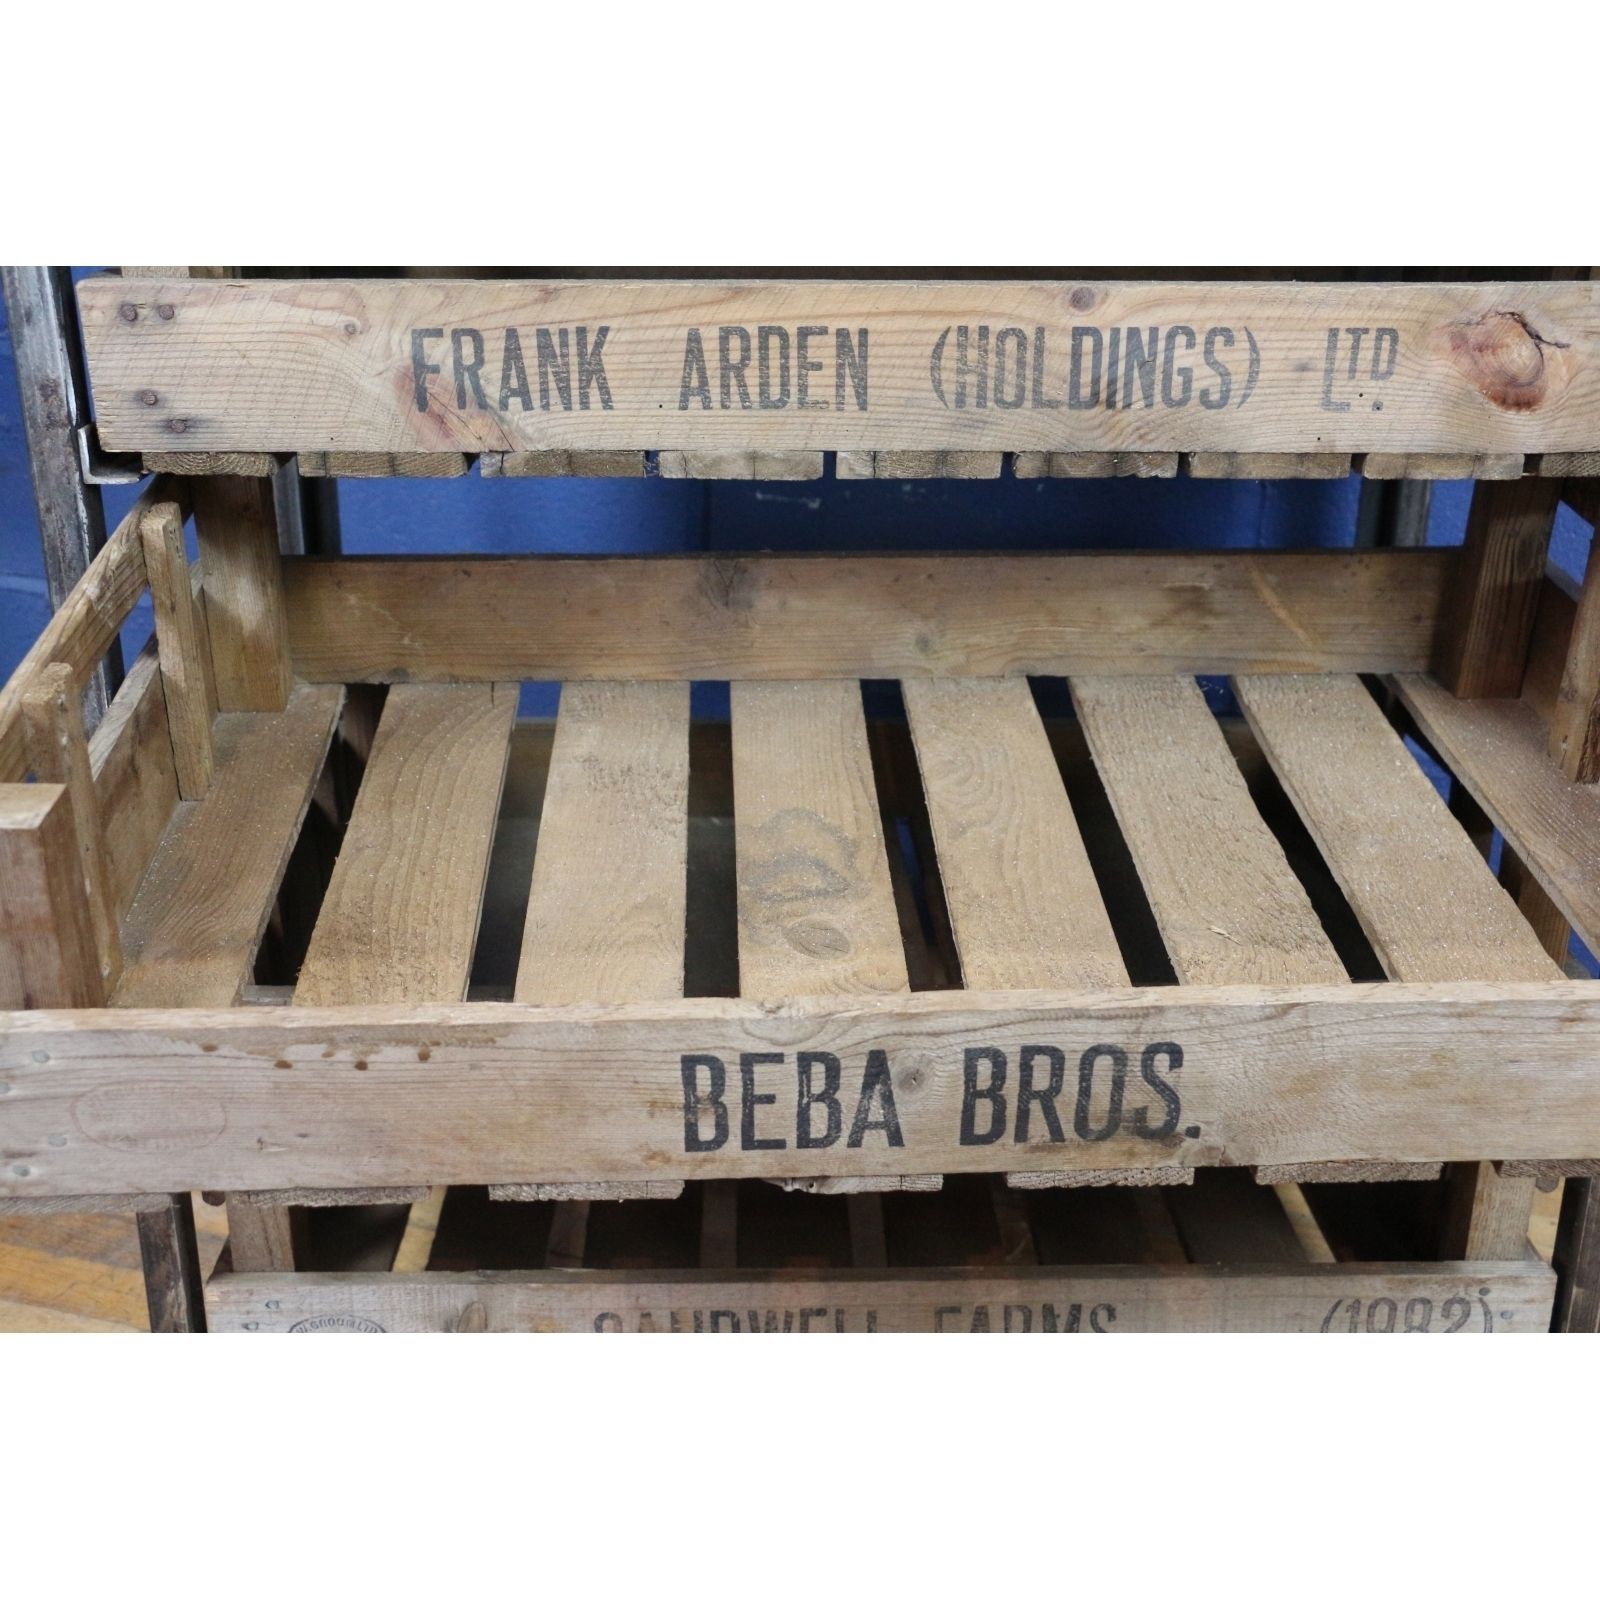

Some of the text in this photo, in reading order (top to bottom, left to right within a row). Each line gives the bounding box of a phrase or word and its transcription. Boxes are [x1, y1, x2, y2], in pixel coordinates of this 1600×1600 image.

[411, 326, 614, 412] FRANK
[678, 325, 869, 411] ARDEN
[930, 325, 1261, 410] (HOLDINGS)
[680, 1042, 1202, 1152] BEBA BROS.
